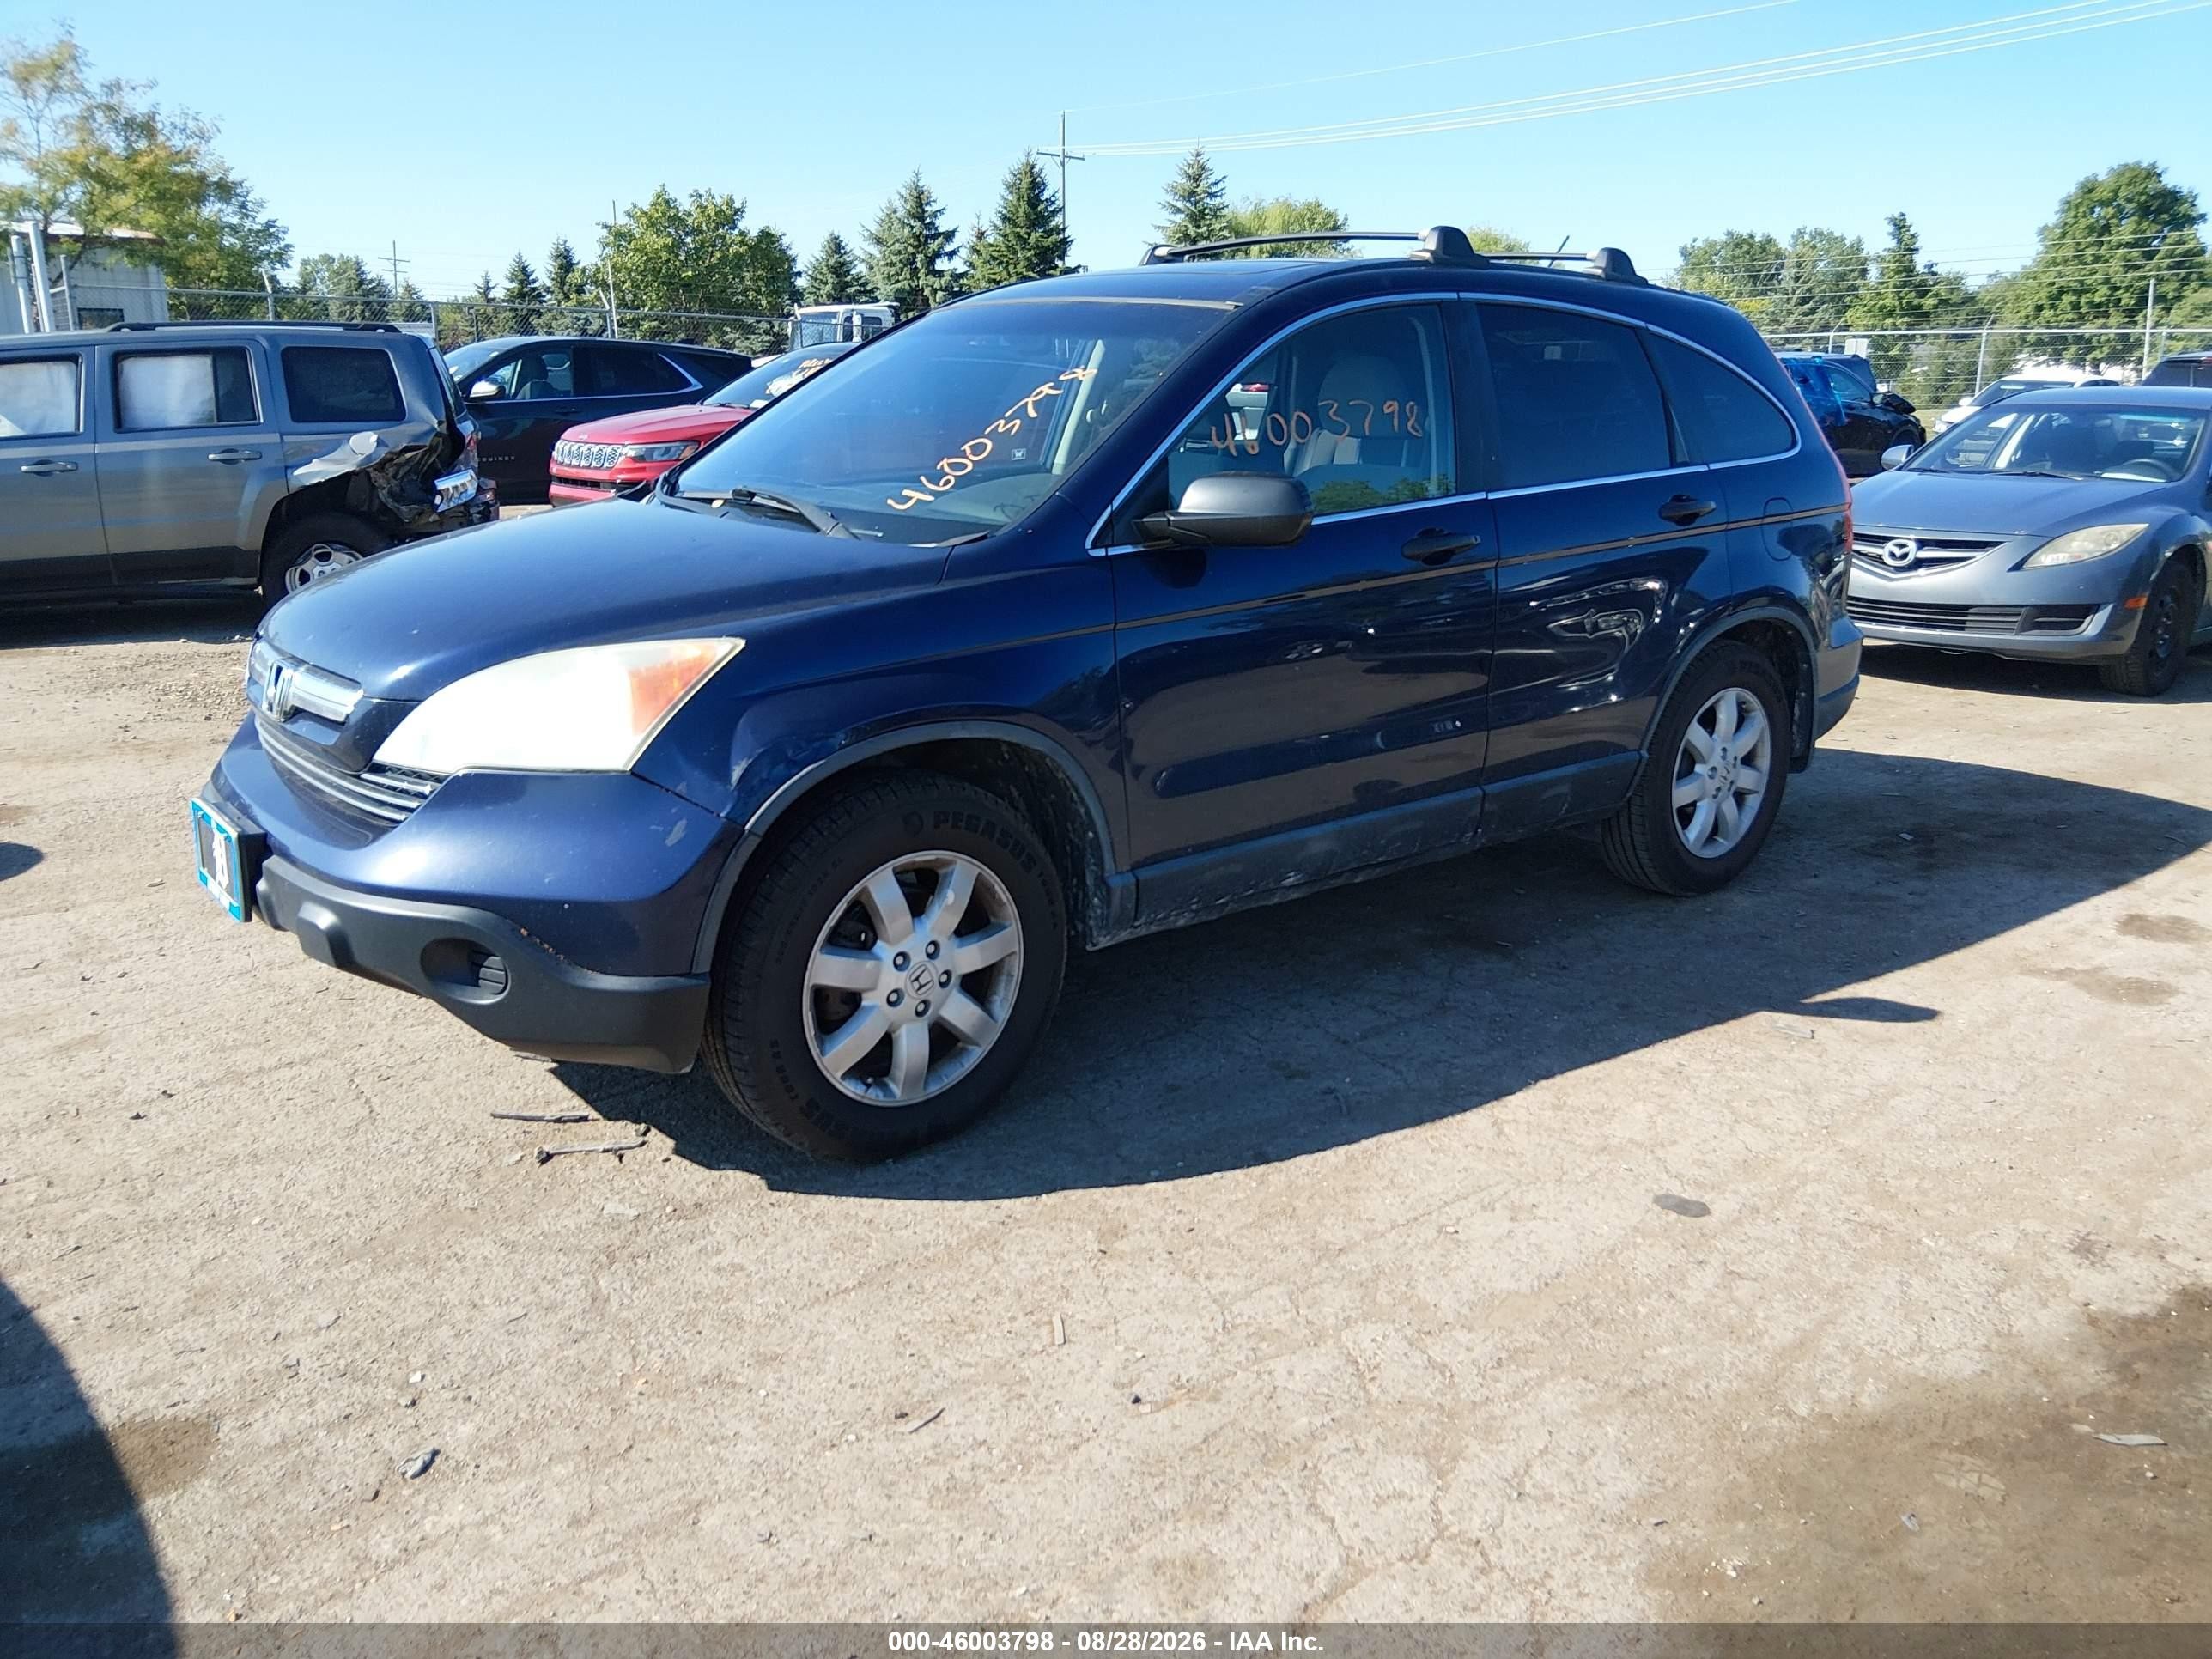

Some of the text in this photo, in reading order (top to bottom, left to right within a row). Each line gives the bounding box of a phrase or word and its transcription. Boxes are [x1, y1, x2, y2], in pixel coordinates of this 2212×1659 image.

[886, 365, 1098, 511] 46003798
[1210, 398, 1424, 457] 46003798
[933, 810, 1037, 873] PEGASUS
